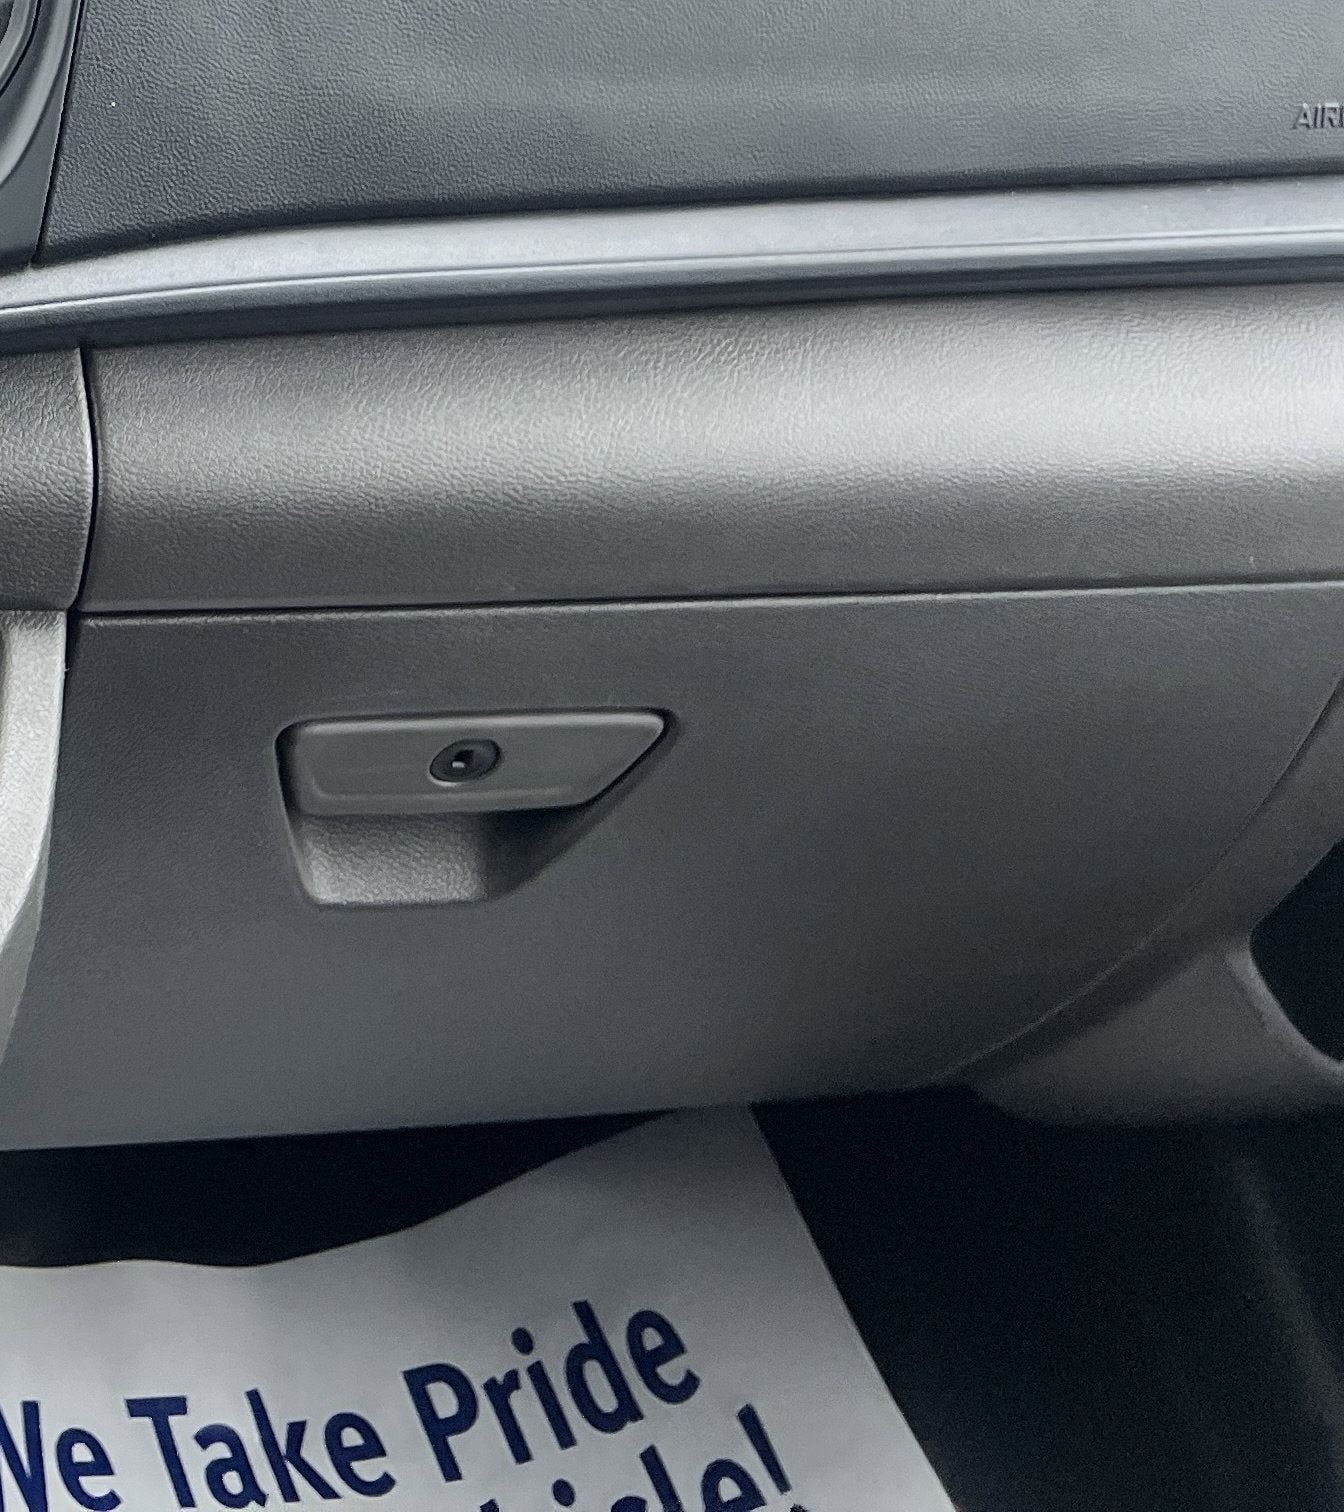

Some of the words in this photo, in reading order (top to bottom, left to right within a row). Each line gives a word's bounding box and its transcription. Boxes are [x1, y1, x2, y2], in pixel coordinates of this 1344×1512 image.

[1292, 102, 1344, 129] AIR
[124, 1389, 397, 1509] Take
[402, 1299, 702, 1483] Pride
